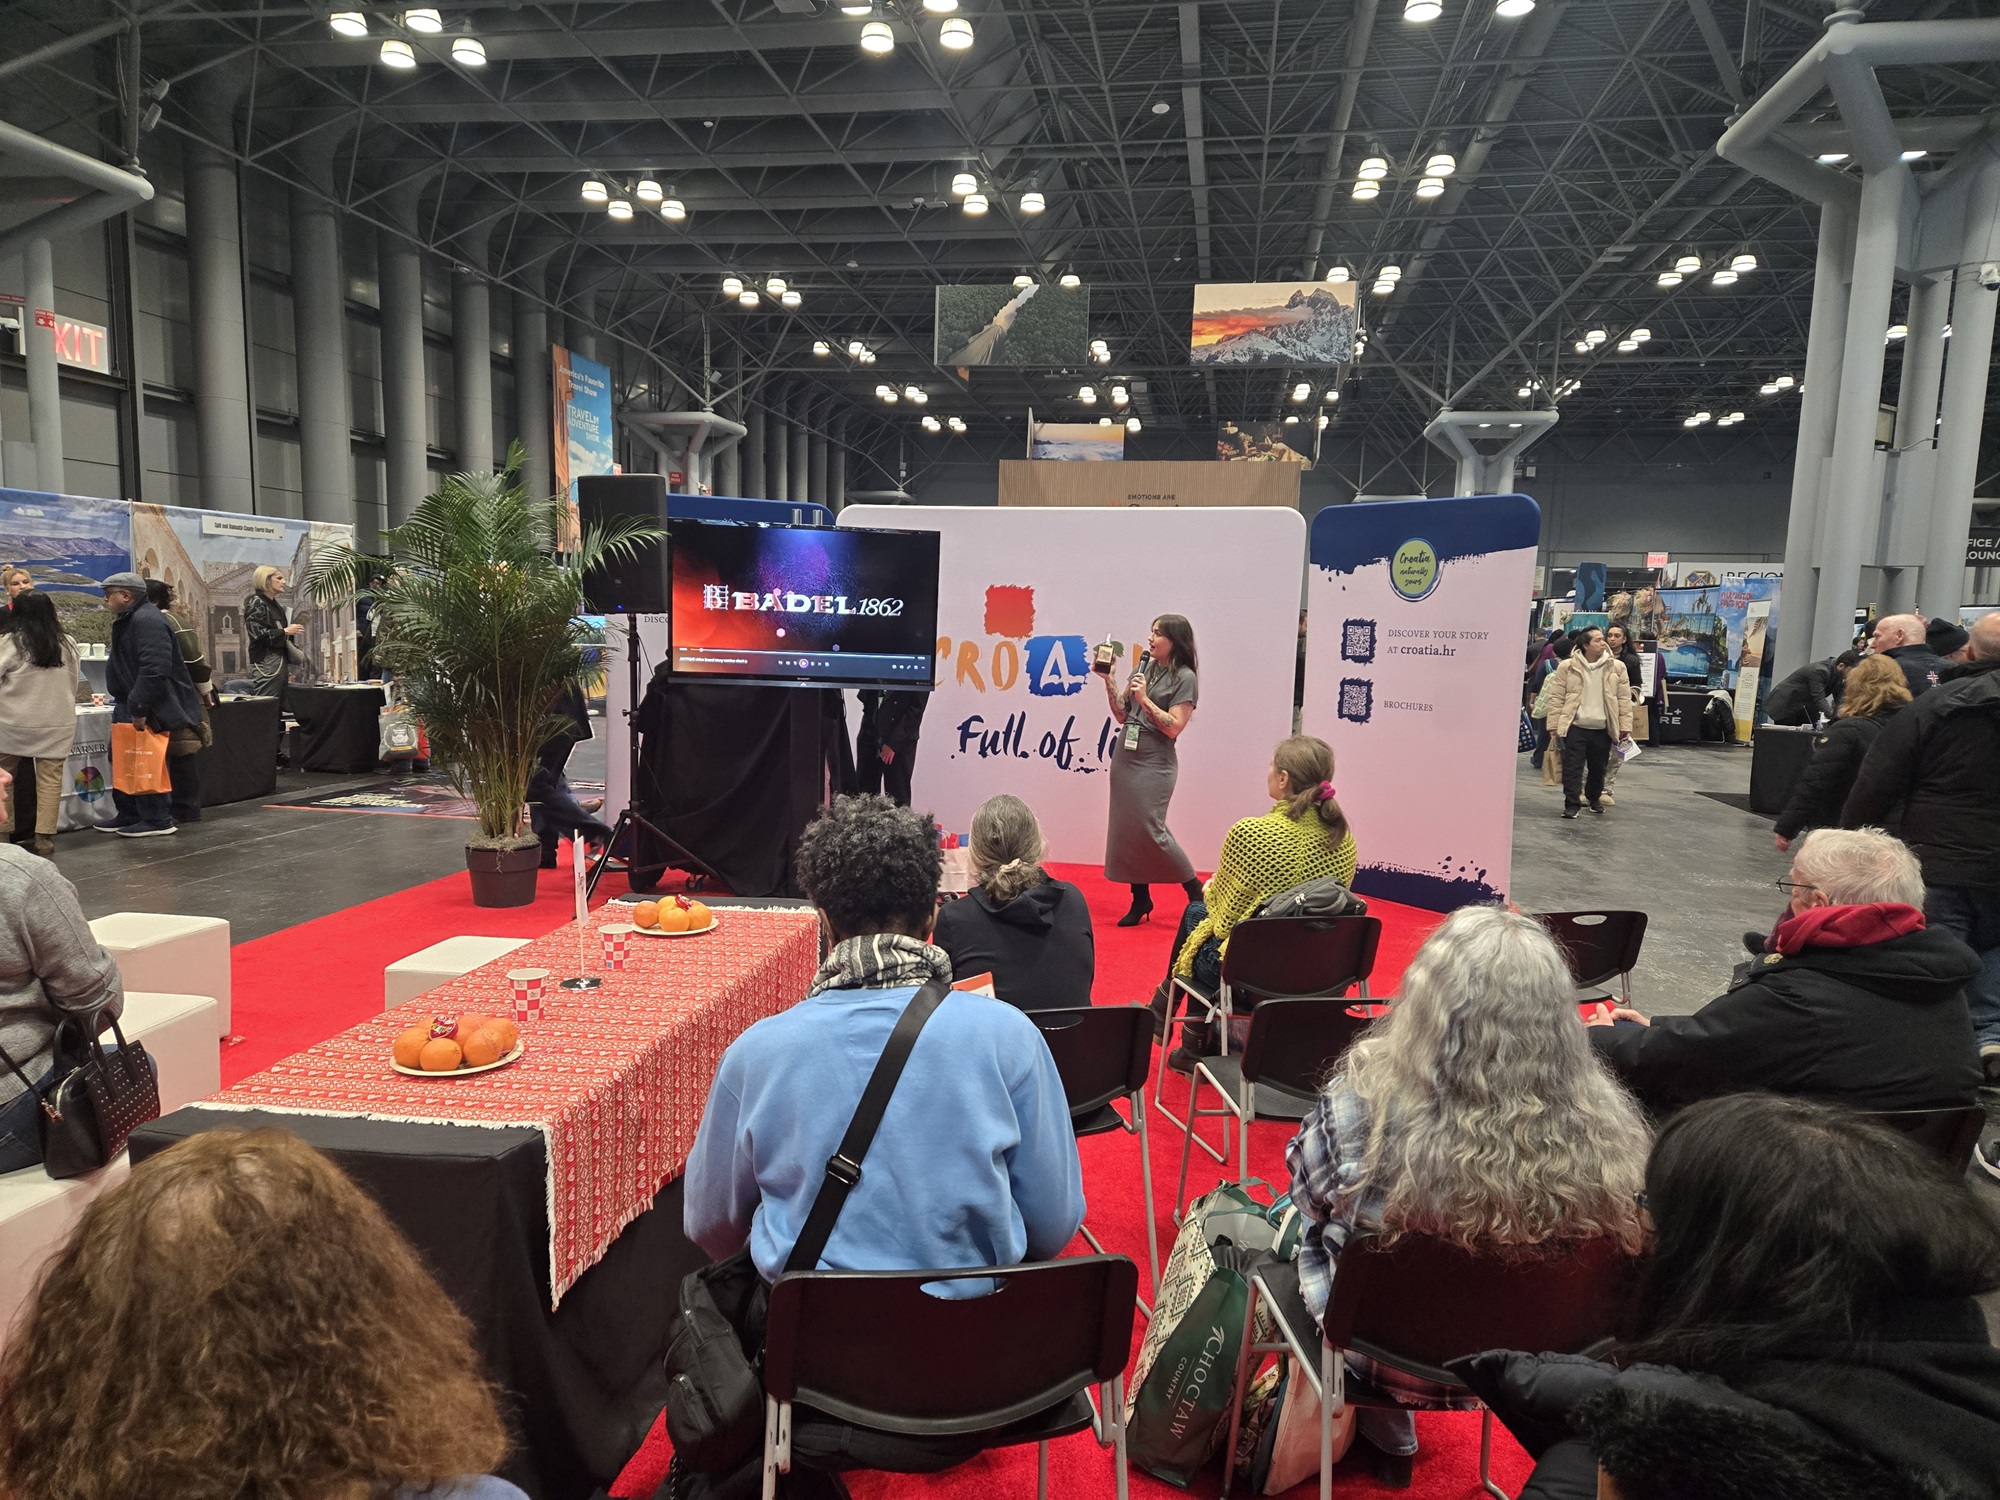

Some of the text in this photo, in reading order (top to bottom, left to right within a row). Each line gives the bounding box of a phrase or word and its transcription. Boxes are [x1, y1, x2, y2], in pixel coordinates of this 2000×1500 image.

[53, 321, 104, 367] XIT
[558, 365, 605, 389] America's Favorite
[567, 380, 598, 398] Travel Show
[567, 418, 600, 435] ADVENTURE
[1966, 538, 1993, 548] FICE
[1400, 550, 1431, 564] Croatia
[1966, 551, 2000, 560] OUN
[1400, 566, 1429, 577] naturally
[731, 592, 857, 615] BADEL
[857, 597, 904, 617] 1862
[1388, 629, 1489, 640] DISCOVER YOUR STORY
[1387, 644, 1456, 657] AT croatia.hr
[1384, 700, 1433, 712] BROCHURES
[1659, 716, 1682, 725] RE
[956, 710, 1120, 770] Full of li
[1165, 1357, 1188, 1400] COUNTRY
[1170, 1335, 1223, 1440] CHOCTAW
